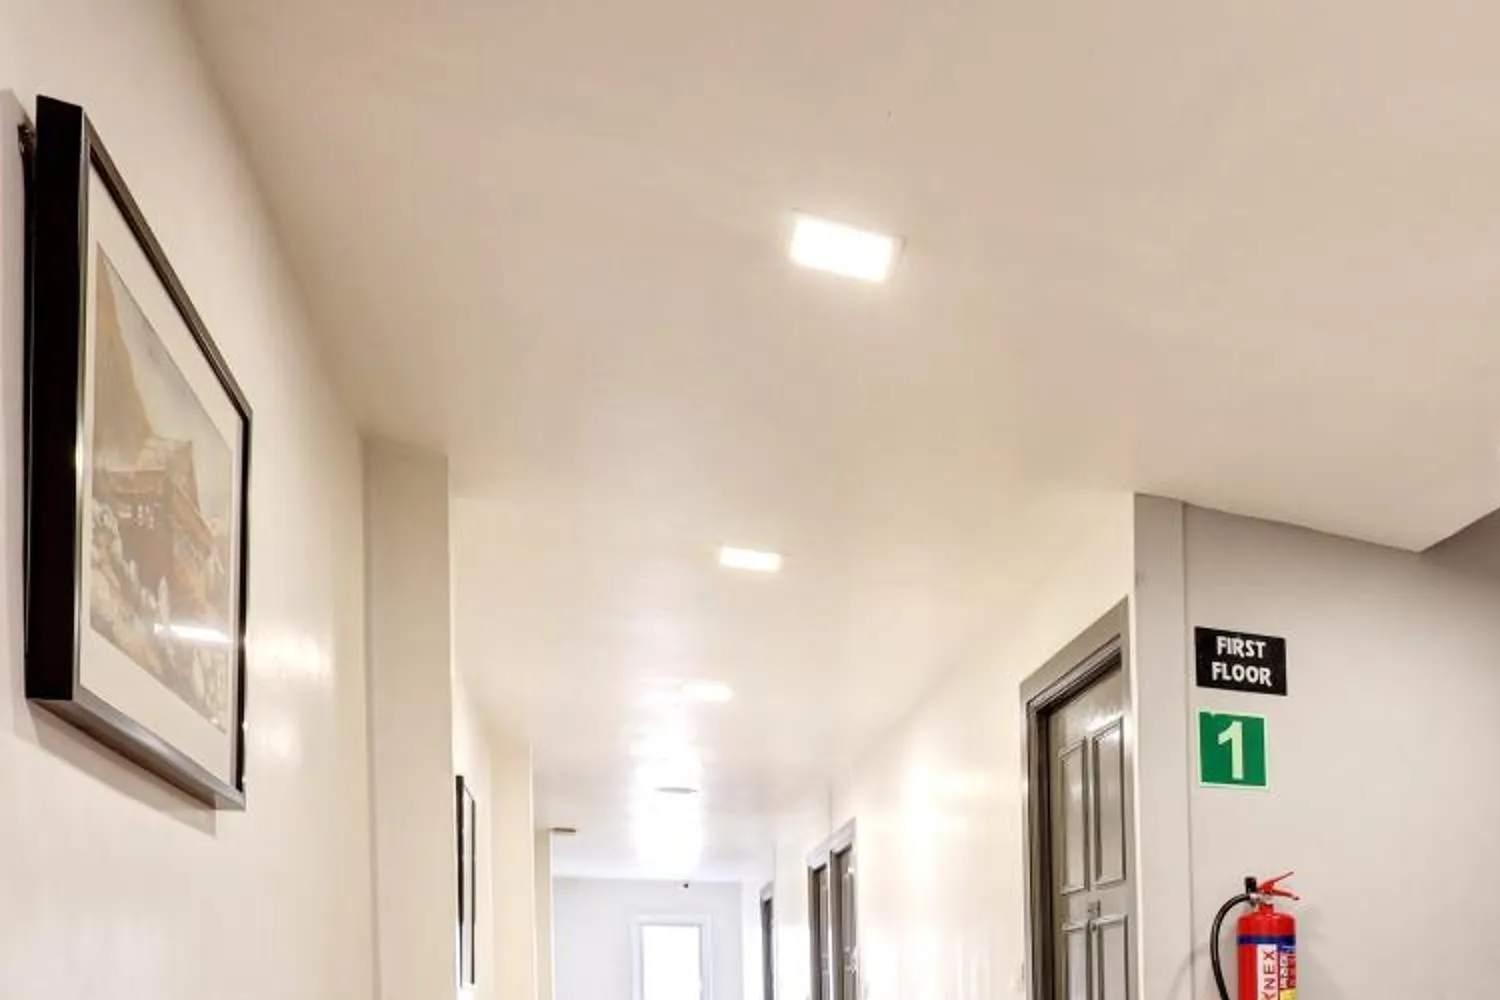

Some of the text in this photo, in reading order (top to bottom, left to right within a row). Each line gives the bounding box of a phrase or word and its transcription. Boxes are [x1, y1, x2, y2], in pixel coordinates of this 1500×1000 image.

[1216, 635, 1267, 659] FIRST
[1211, 661, 1272, 687] FLOOR
[1218, 720, 1243, 780] 1
